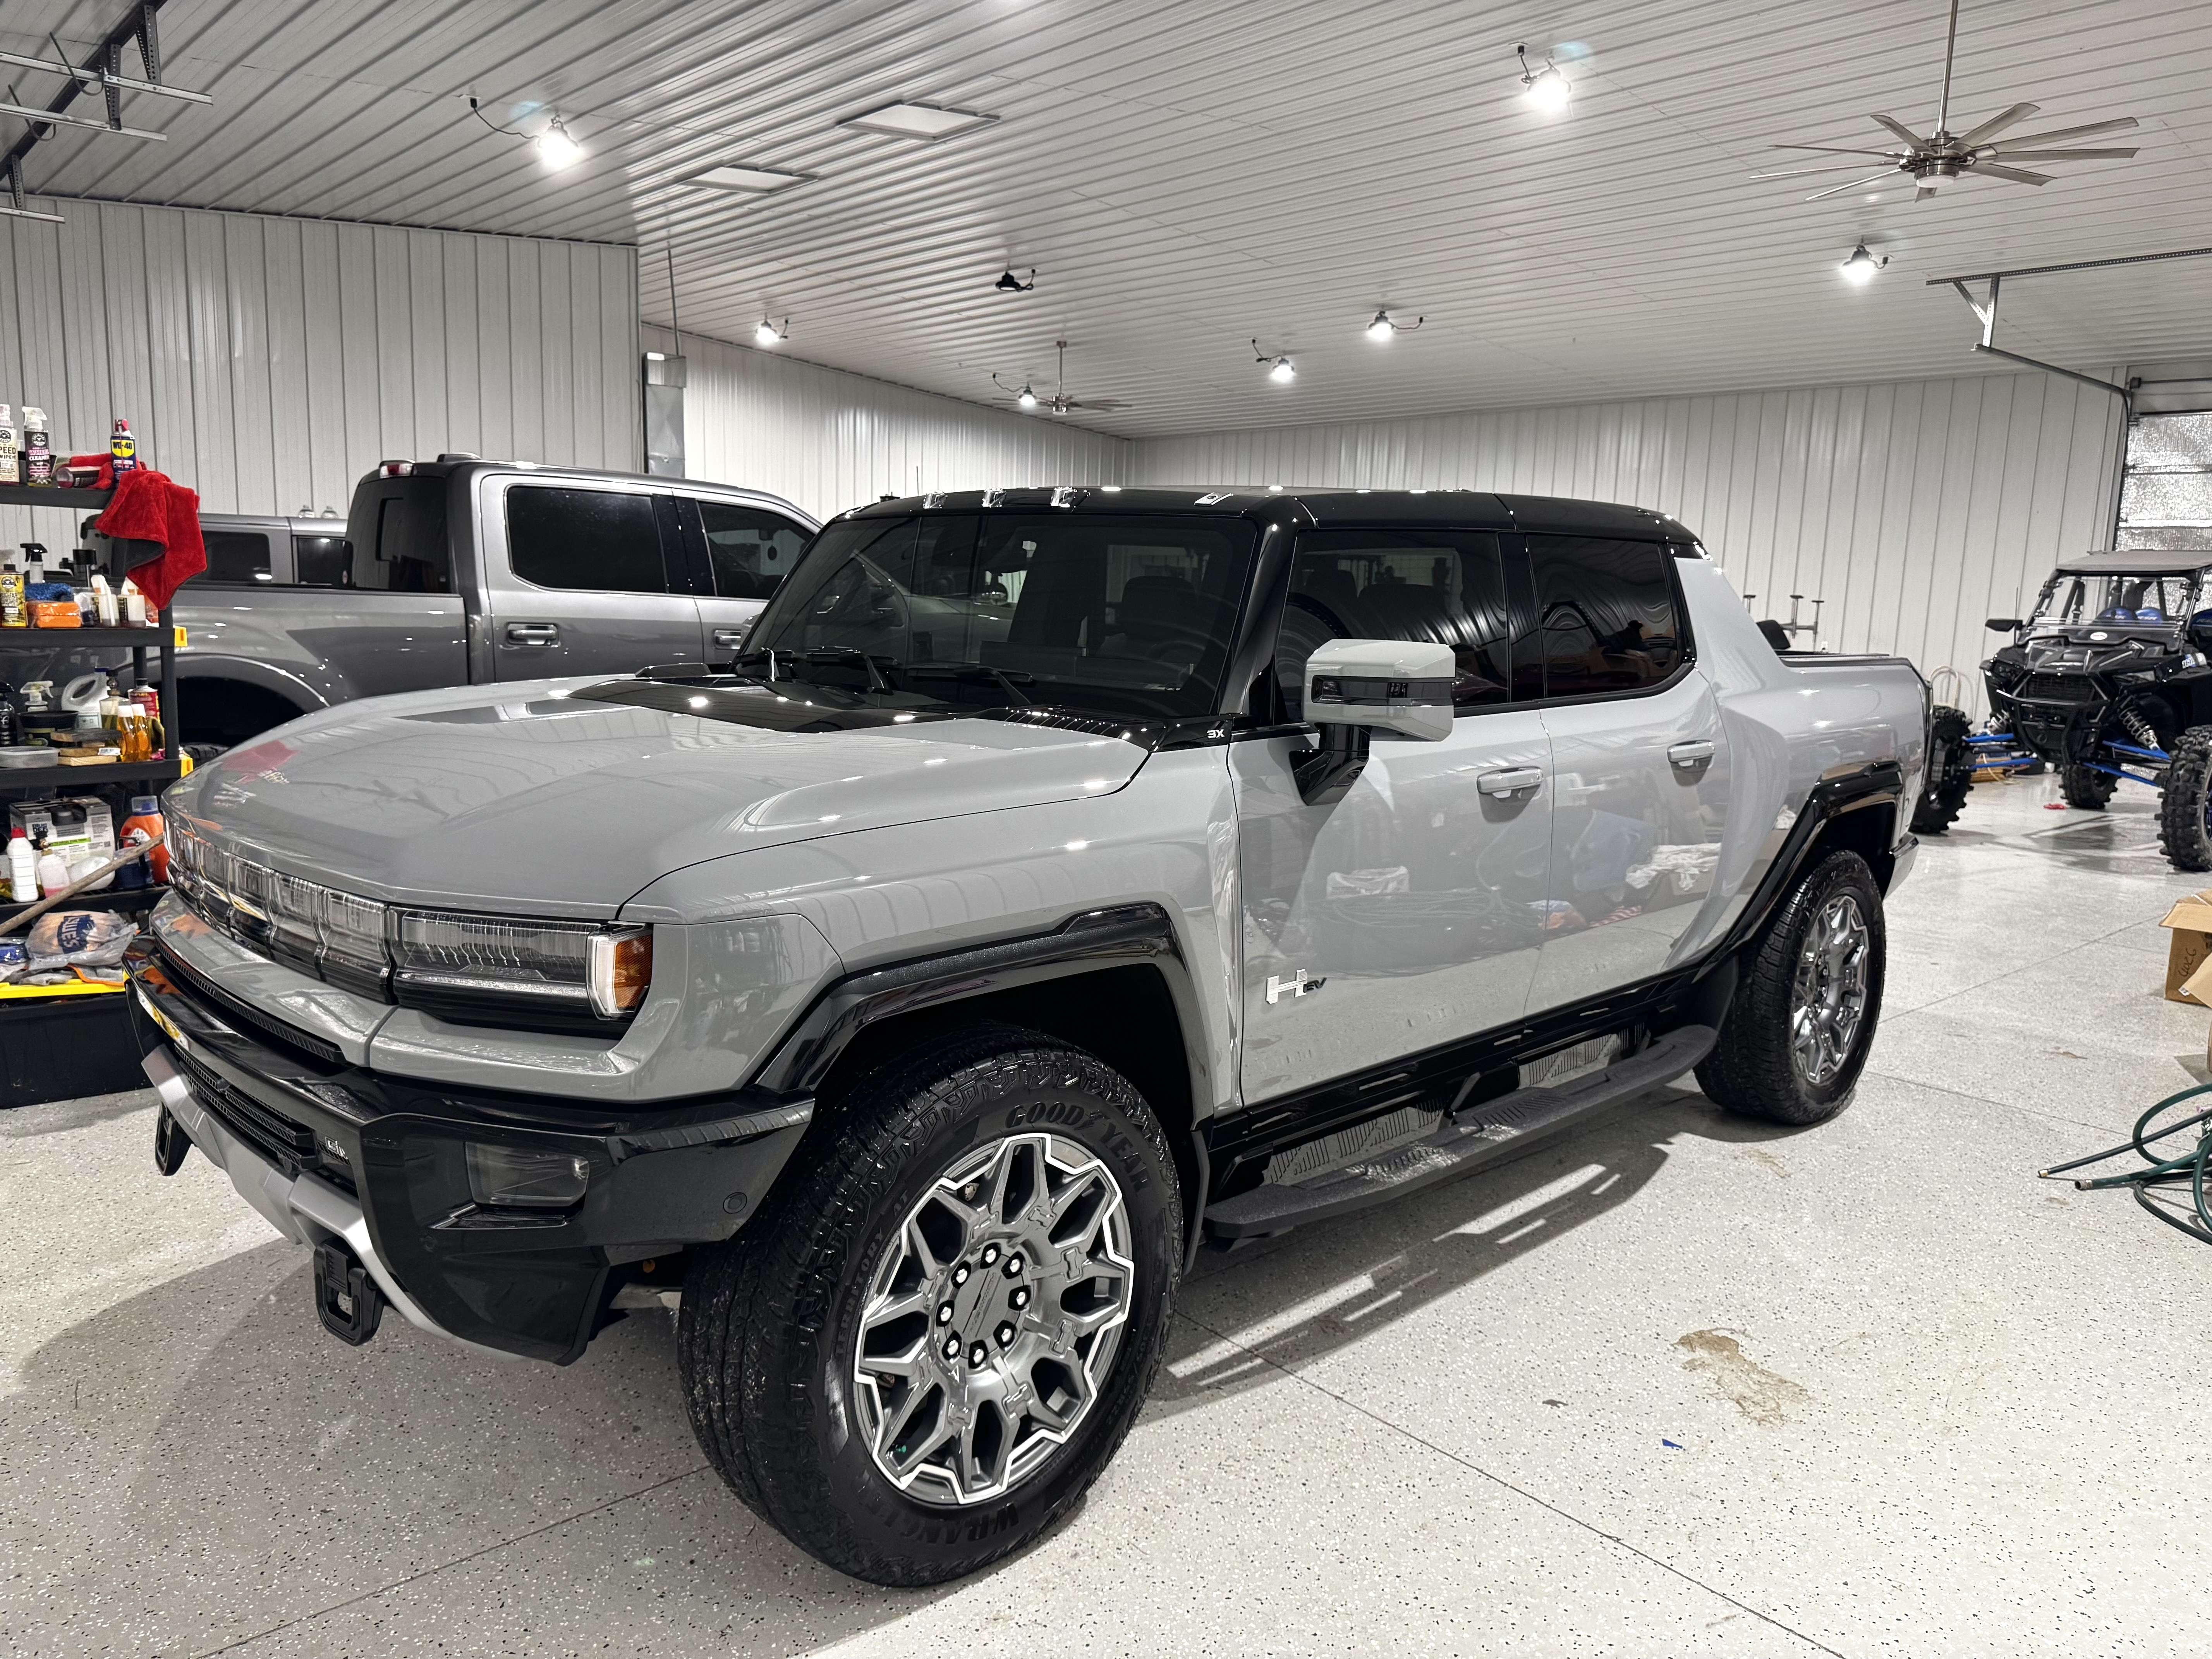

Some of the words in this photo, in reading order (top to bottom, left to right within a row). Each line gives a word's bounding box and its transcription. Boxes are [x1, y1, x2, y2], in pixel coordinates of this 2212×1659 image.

[0, 446, 16, 454] PEED
[113, 441, 132, 450] WD-40
[1207, 729, 1225, 739] 3X
[835, 1227, 884, 1357] TERRITORY
[894, 1190, 907, 1216] AT
